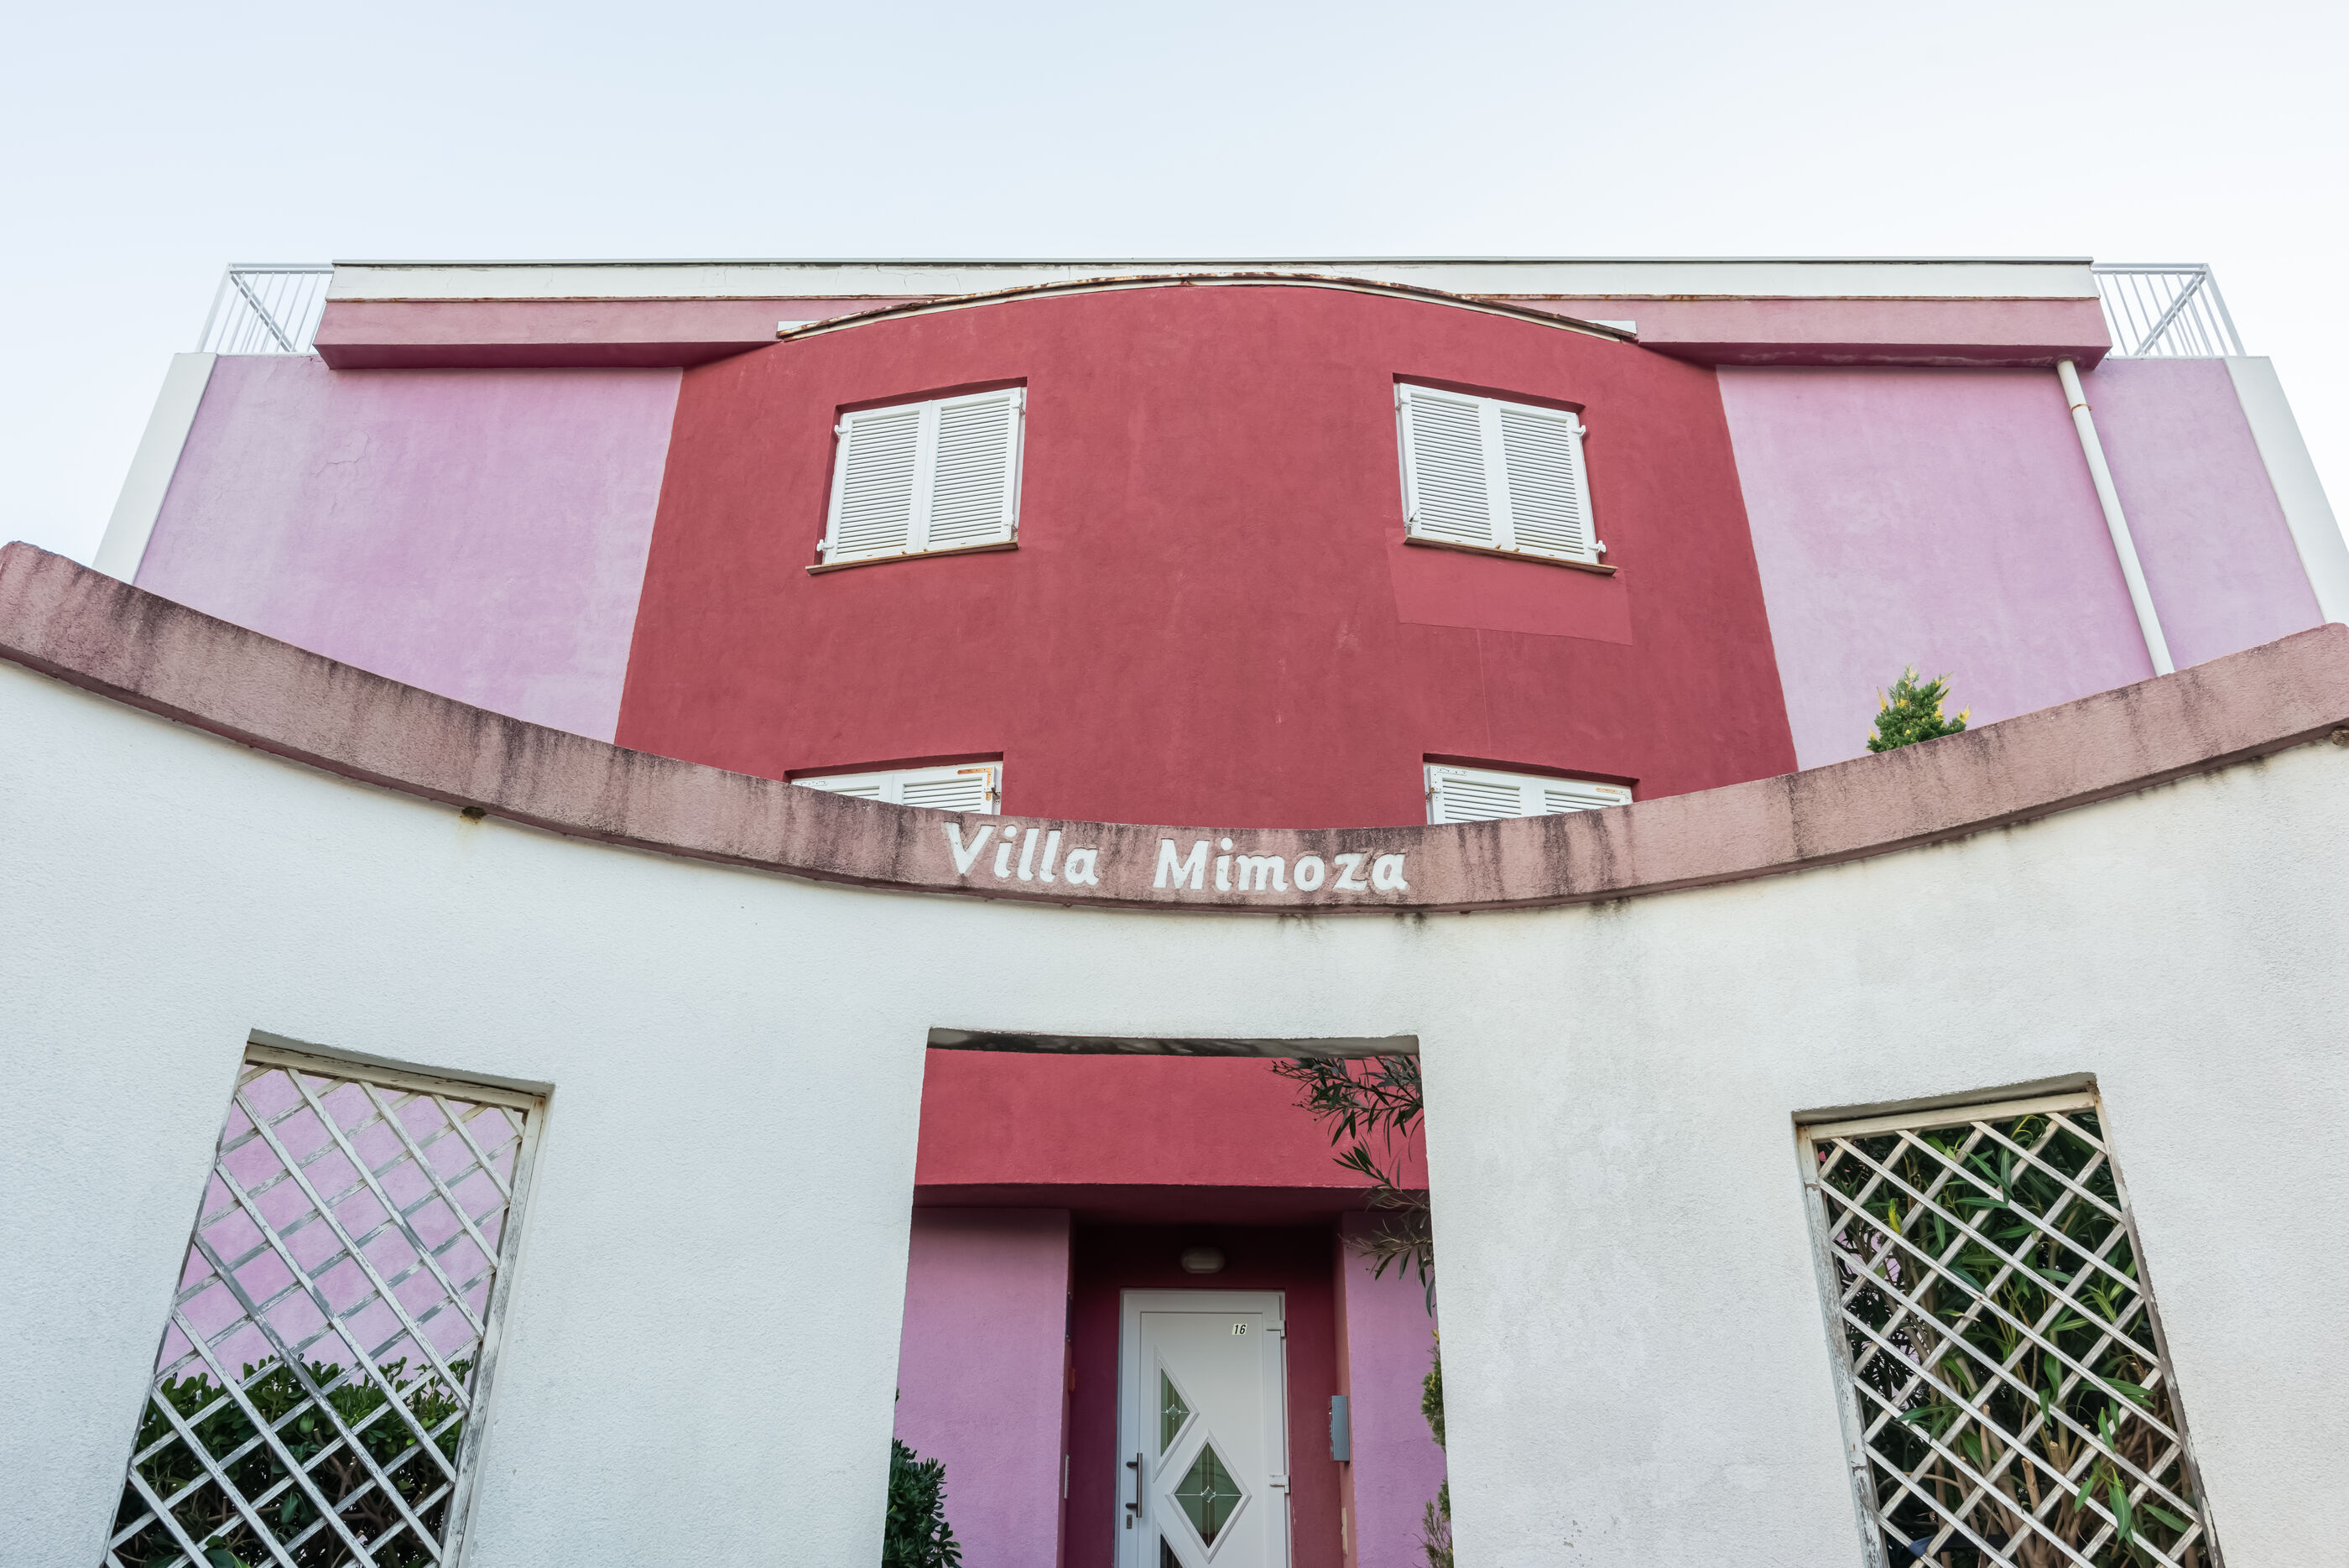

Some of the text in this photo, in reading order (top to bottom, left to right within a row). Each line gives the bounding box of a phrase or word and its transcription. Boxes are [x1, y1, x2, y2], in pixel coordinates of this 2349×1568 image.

[944, 821, 1409, 892] Villa Mimoza
[1234, 1324, 1247, 1335] 16
